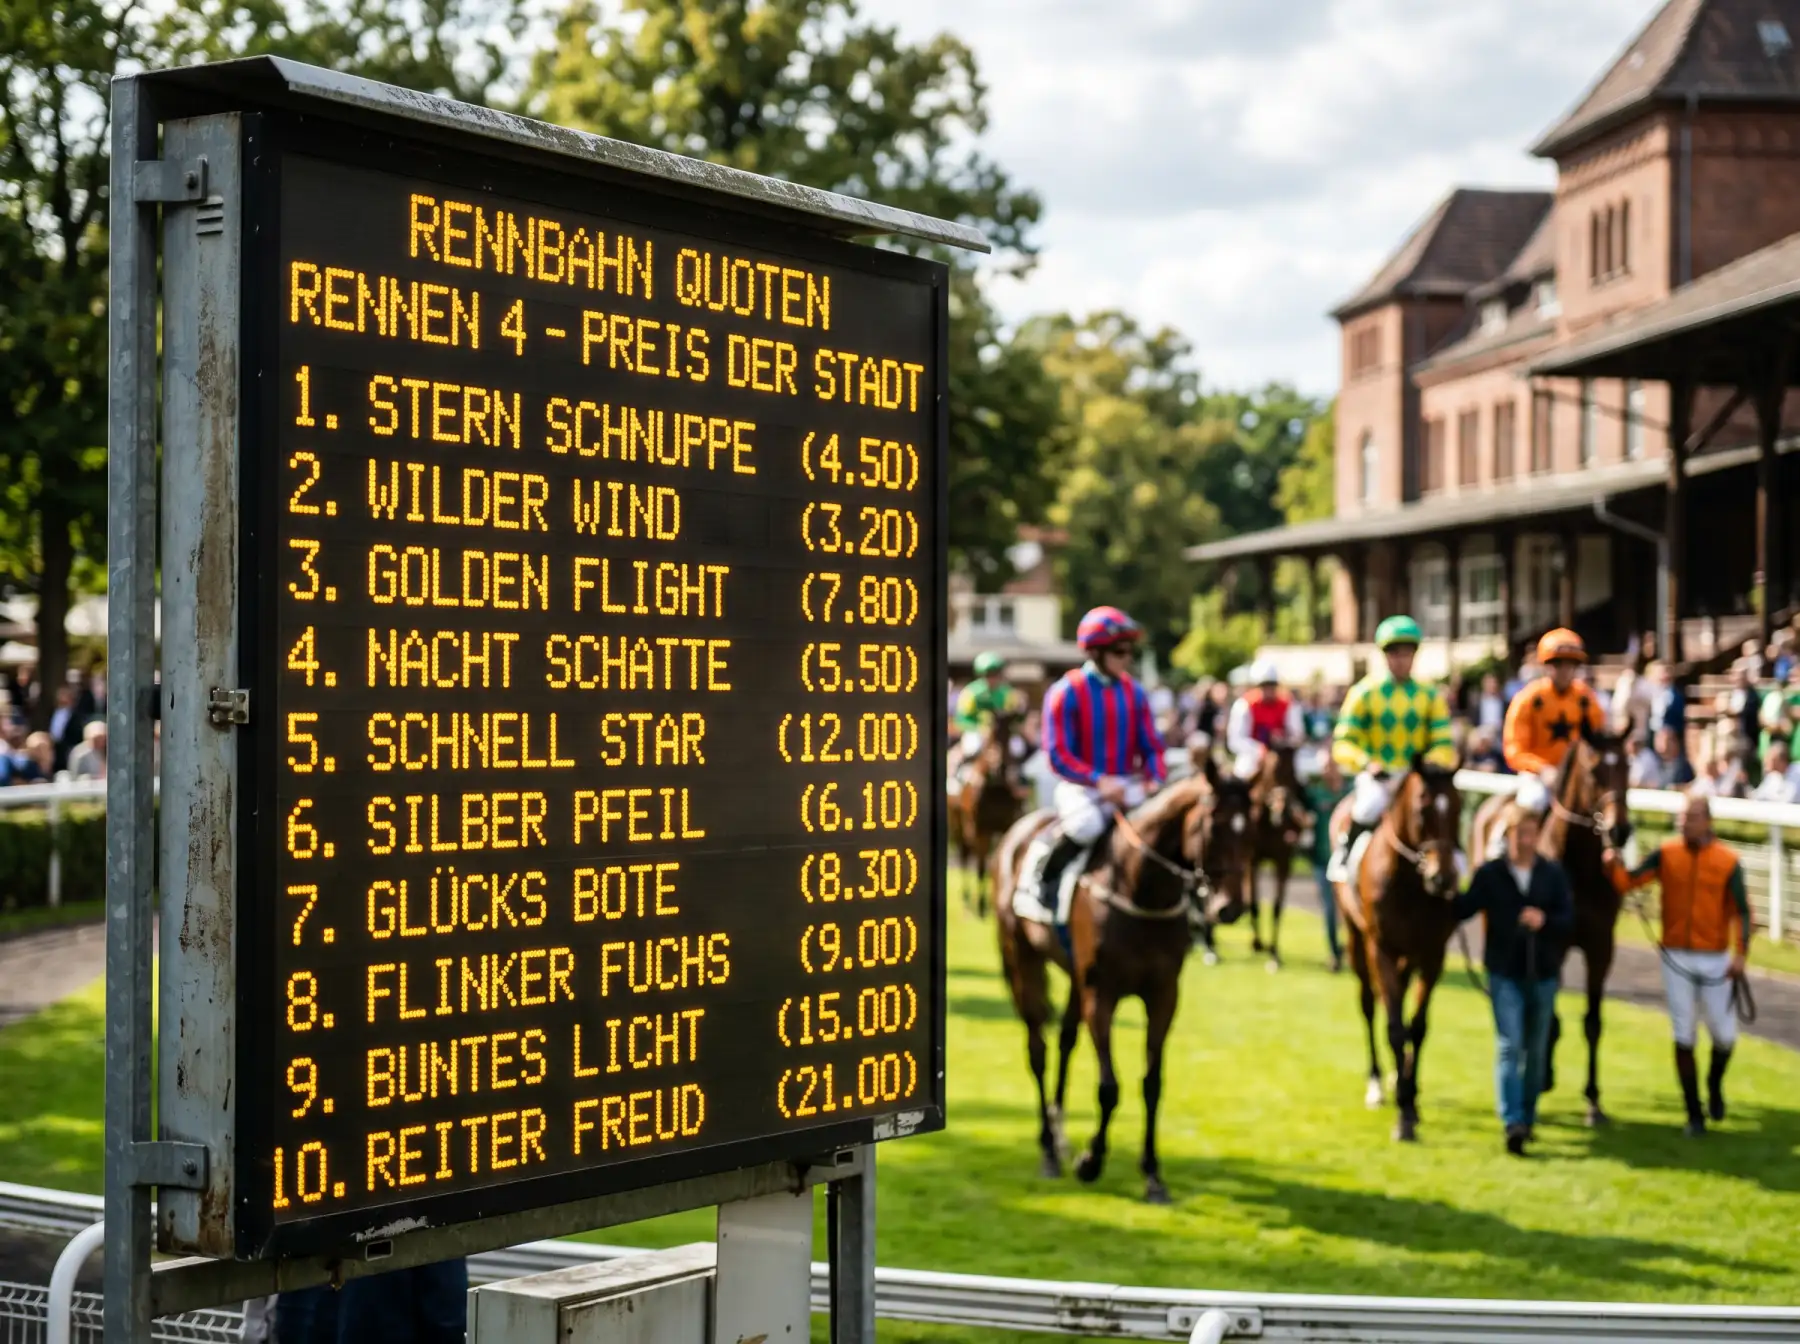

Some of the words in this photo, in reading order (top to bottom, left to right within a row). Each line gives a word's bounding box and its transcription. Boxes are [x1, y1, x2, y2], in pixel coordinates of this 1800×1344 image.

[411, 194, 652, 299] RENNBAHN
[677, 249, 829, 330] QUOTEN
[291, 261, 479, 349] RENNEN
[501, 300, 526, 355] 4
[583, 310, 709, 381] PREIS
[728, 334, 797, 395] DER
[815, 349, 924, 412] STADT
[296, 366, 337, 429] 1.
[369, 375, 520, 449] STERN
[547, 398, 756, 474] SCHNUPPE
[803, 432, 918, 491] (4.50)
[290, 452, 336, 516] 2.
[369, 459, 548, 531] WILDER
[574, 479, 680, 540] WIND
[802, 502, 918, 558] (3.20)
[289, 539, 336, 601] 3.
[369, 544, 548, 610] GOLDEN
[574, 557, 729, 617] FLIGHT
[802, 573, 918, 625] (7.80)
[288, 626, 336, 687] 4.
[368, 628, 519, 688] NACHT
[546, 634, 731, 690] SCHATTE
[802, 643, 917, 693] (5.50)
[288, 713, 335, 772] 5.
[367, 713, 575, 771] SCHNELL
[601, 713, 705, 766] STAR
[779, 713, 917, 762] (12.00)
[288, 799, 334, 859] 6.
[368, 792, 547, 855] SILBER
[574, 788, 705, 844] PFEIL
[801, 781, 917, 832] (6.10)
[288, 885, 334, 945] 7.
[368, 866, 546, 939] GLÜCKS
[574, 863, 679, 922] BOTE
[801, 848, 917, 903] (8.30)
[287, 971, 334, 1031] 8.
[368, 947, 574, 1022] FLINKER
[602, 933, 729, 996] FUCHS
[801, 916, 916, 973] (9.00)
[287, 1058, 333, 1117] 9.
[368, 1029, 546, 1107] BUNTES
[574, 1009, 705, 1077] LICHT
[778, 984, 916, 1047] (15.00)
[274, 1141, 345, 1208] 10.
[368, 1108, 546, 1190] REITER
[574, 1084, 704, 1154] FREUD
[778, 1051, 916, 1118] (21.00)
